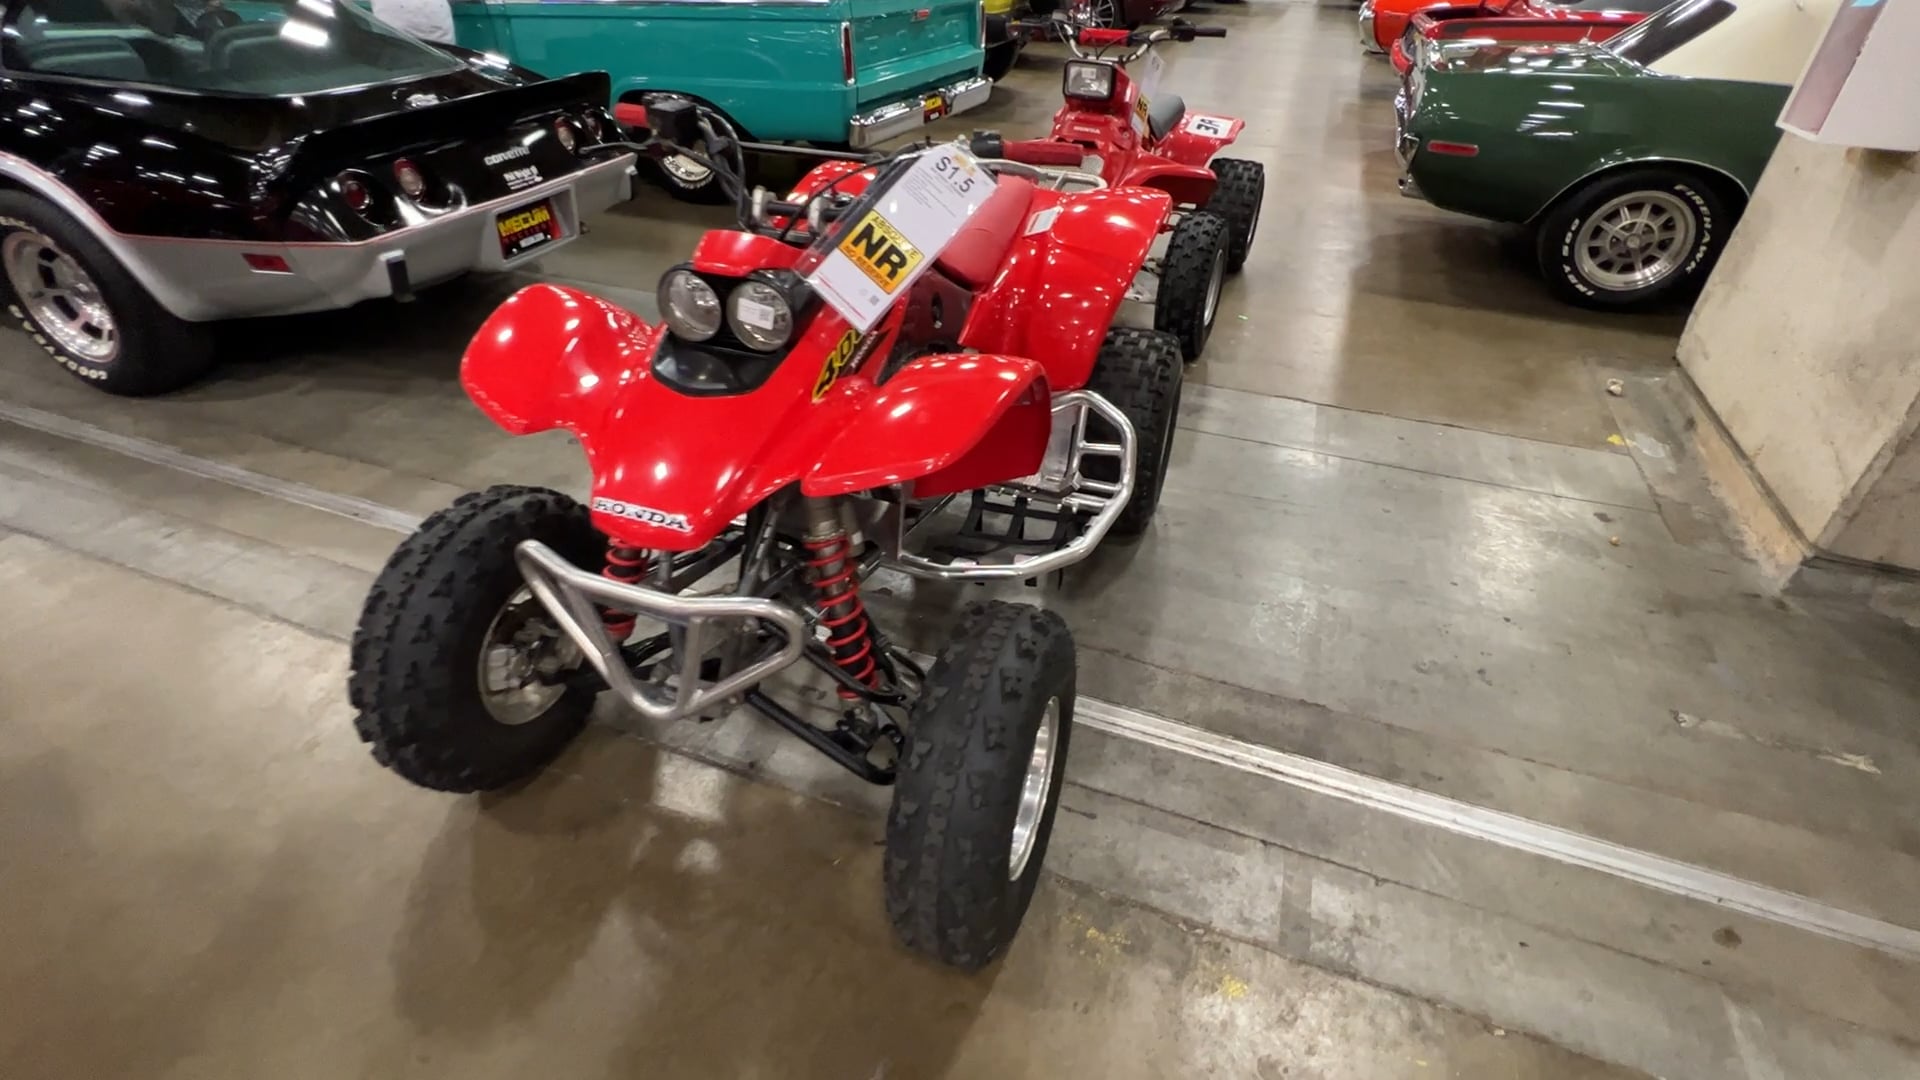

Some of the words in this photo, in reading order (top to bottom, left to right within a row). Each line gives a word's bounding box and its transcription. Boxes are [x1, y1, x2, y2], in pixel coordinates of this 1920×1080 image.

[935, 156, 975, 194] S1.5
[497, 205, 551, 237] MECUM
[870, 214, 919, 259] ABSOLE
[1562, 218, 1580, 257] 500
[1673, 184, 1712, 273] FIREHAWK
[851, 222, 908, 281] NR
[1562, 264, 1595, 296] INDY
[812, 328, 863, 404] 40
[594, 498, 689, 531] HONDA
